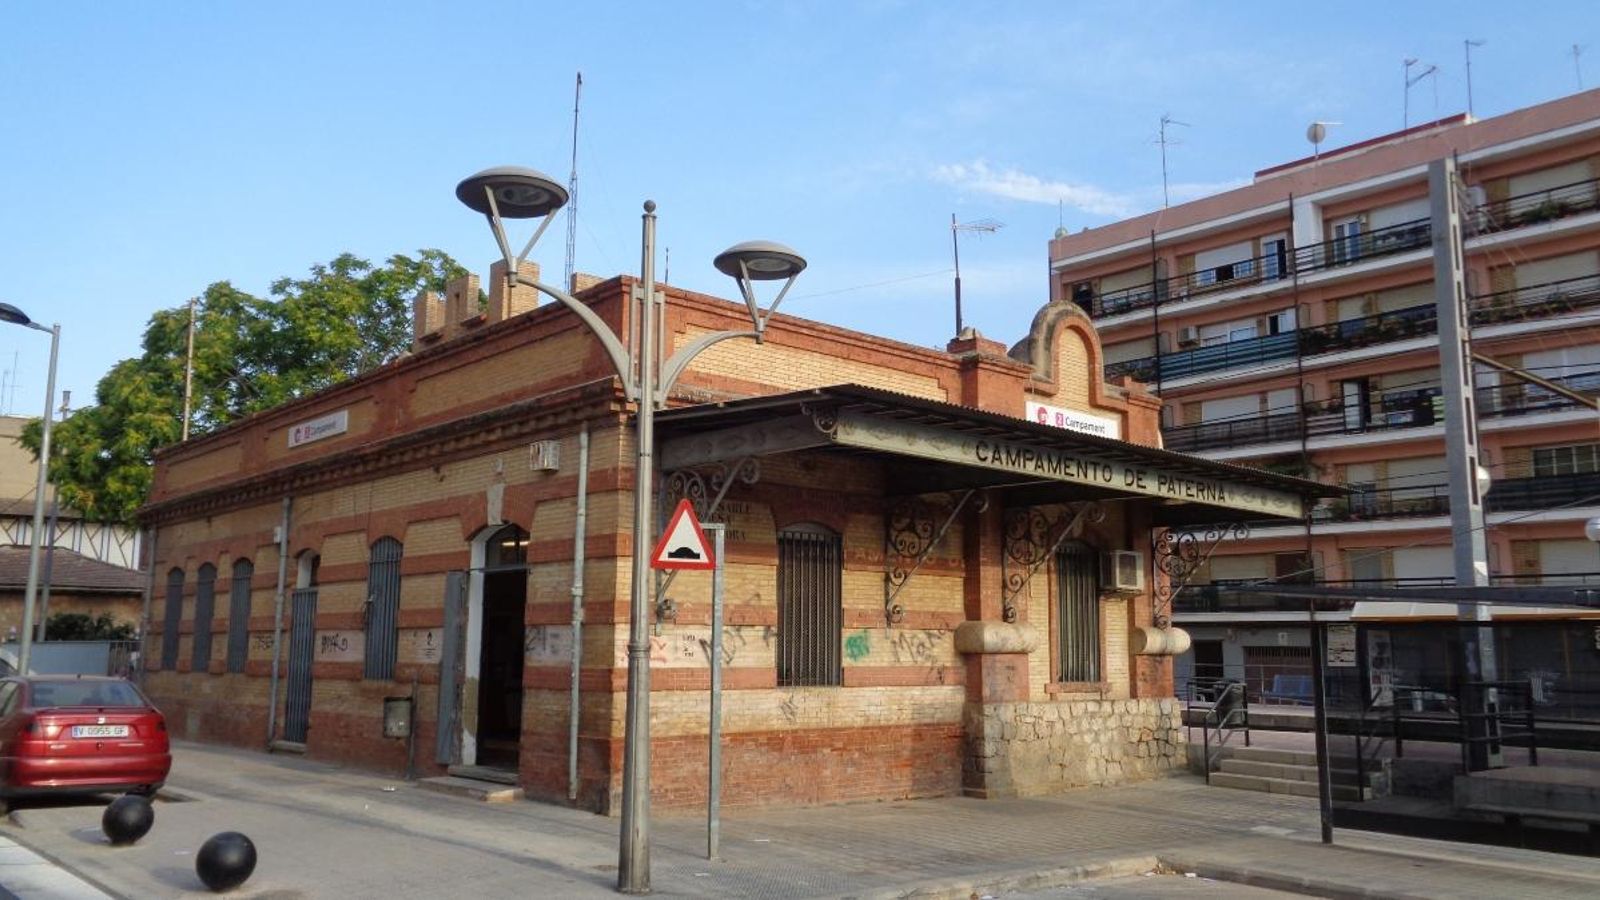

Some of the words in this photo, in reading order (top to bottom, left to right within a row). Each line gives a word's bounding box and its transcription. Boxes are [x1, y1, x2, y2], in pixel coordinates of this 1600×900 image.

[1065, 416, 1106, 434] Campament
[975, 440, 1113, 483] CAMPAMENTO
[1124, 468, 1147, 489] DE
[1157, 473, 1226, 502] PATERNA
